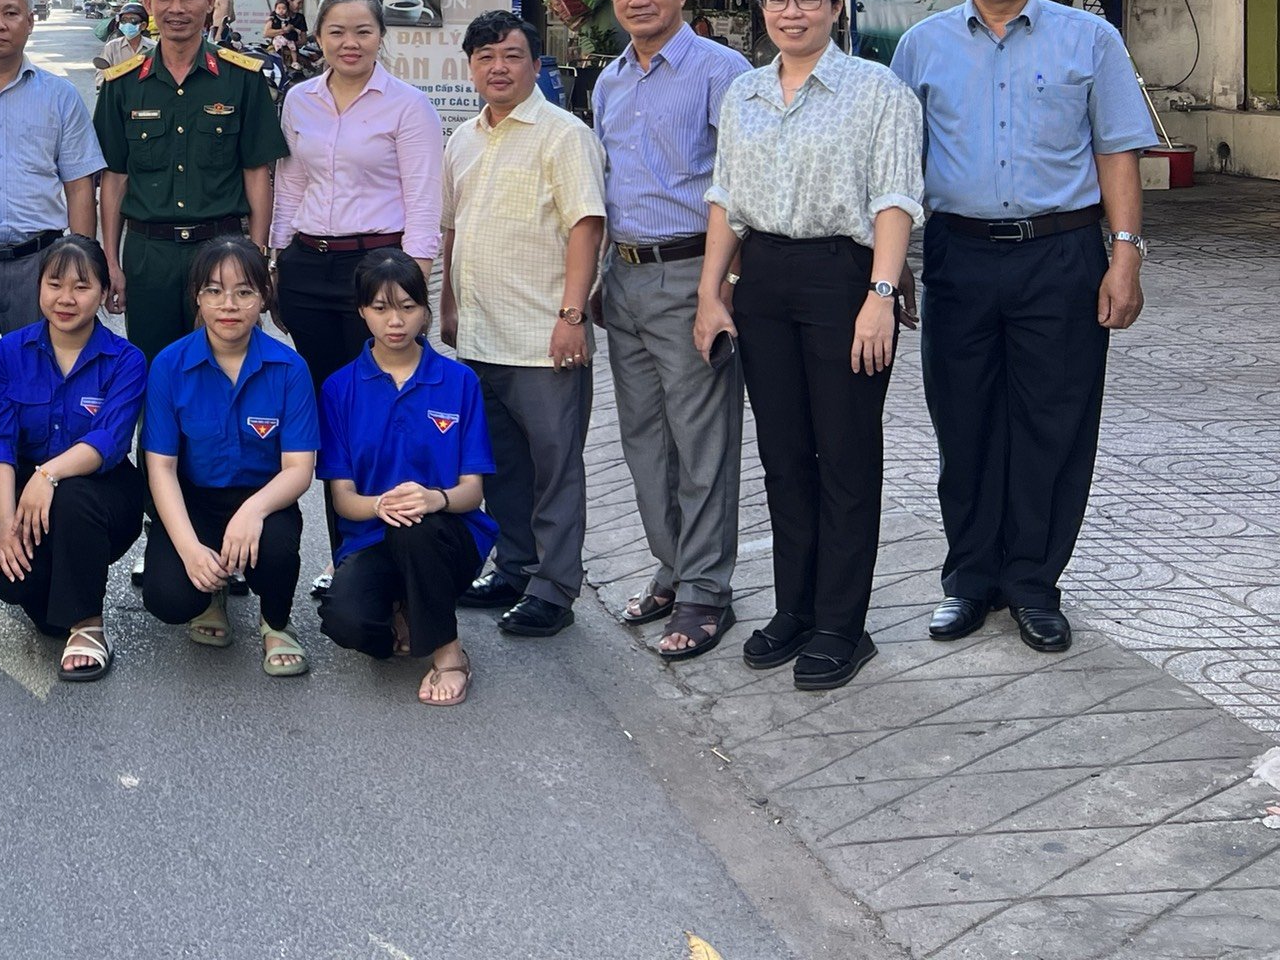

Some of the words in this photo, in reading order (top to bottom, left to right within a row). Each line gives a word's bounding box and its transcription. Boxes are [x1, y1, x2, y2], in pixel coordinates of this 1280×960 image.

[397, 31, 432, 48] ĐẠI
[439, 29, 462, 45] LÝ
[449, 96, 470, 106] CÁC
